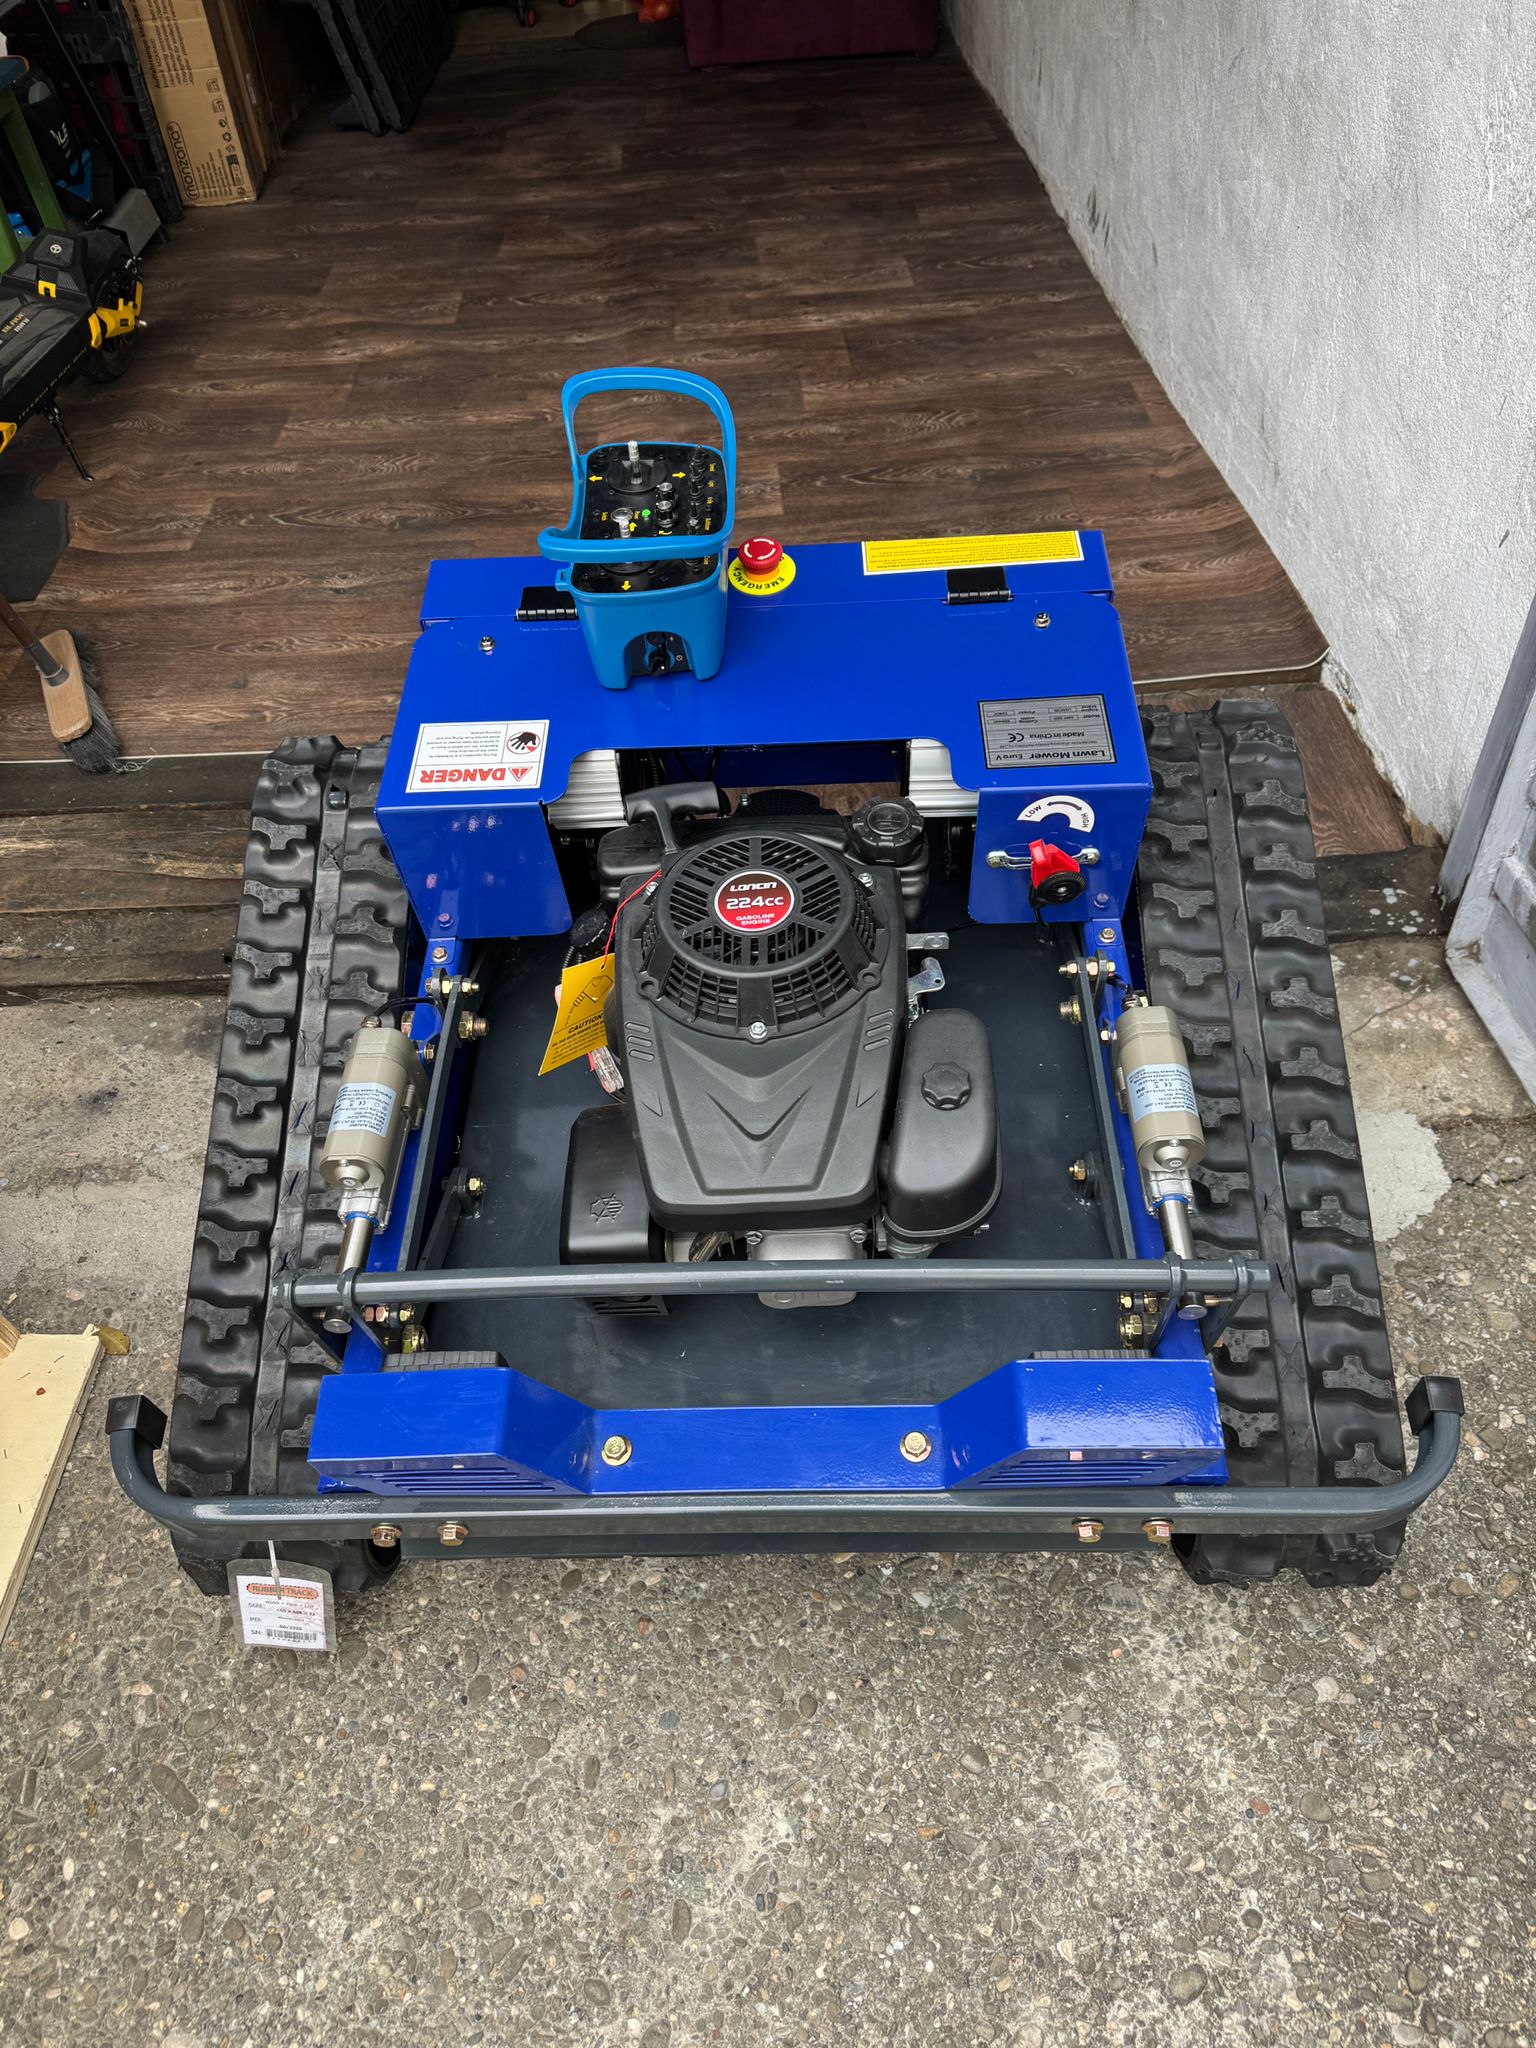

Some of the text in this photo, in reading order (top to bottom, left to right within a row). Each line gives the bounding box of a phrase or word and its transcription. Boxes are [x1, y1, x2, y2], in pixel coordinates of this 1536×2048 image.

[733, 566, 785, 590] EMERGENCY
[1030, 751, 1069, 760] Mower
[1072, 749, 1104, 758] Lawn
[420, 767, 507, 784] DANGER
[1024, 804, 1042, 818] LOW
[1080, 812, 1089, 828] HIGH
[730, 881, 778, 892] LONCIN
[735, 913, 775, 921] GASOLINE
[740, 918, 771, 926] ENGINE
[568, 1013, 604, 1034] CAUTION
[252, 1584, 313, 1596] RUBBR TRACK
